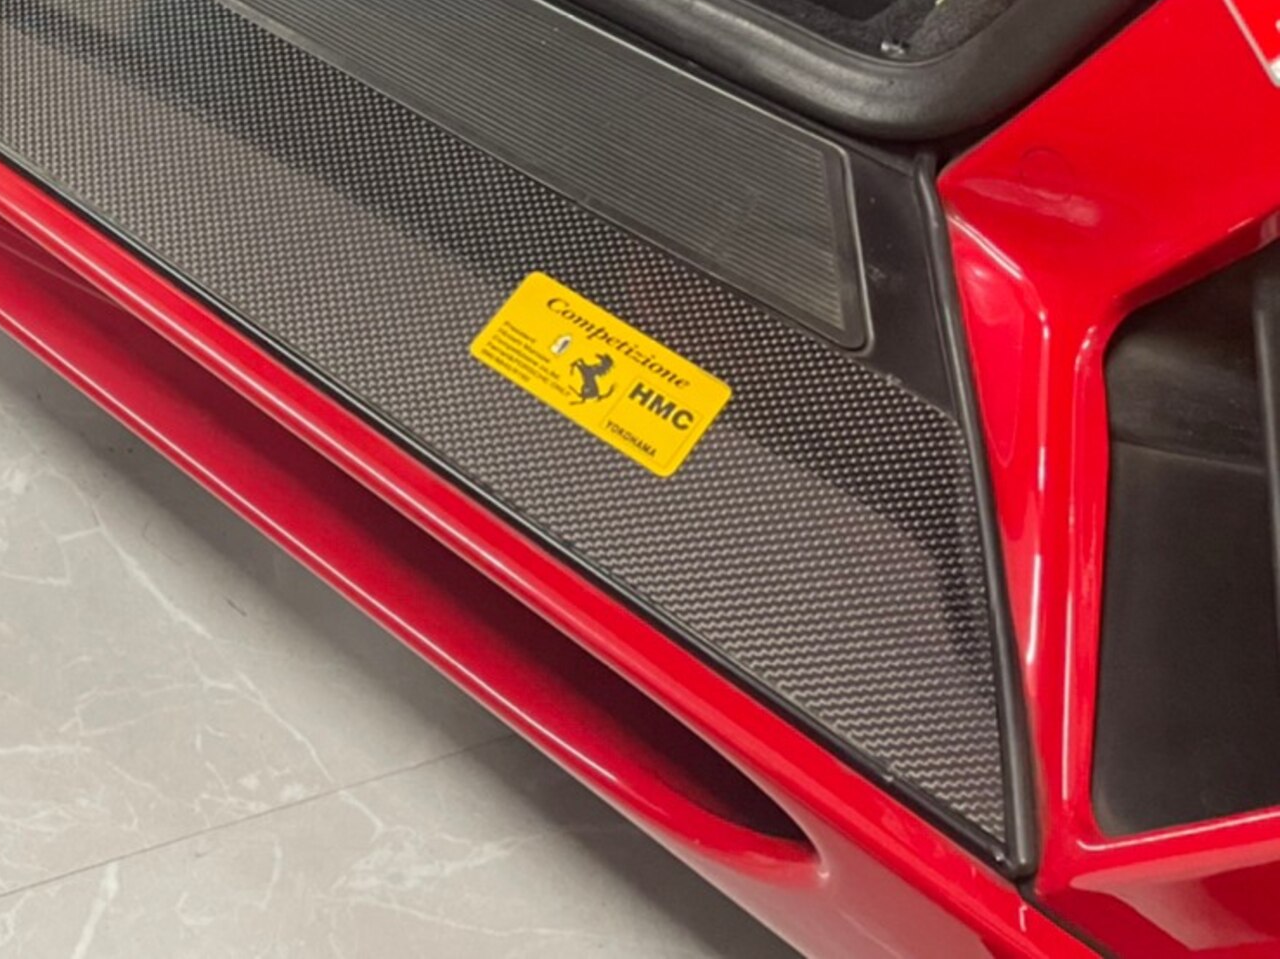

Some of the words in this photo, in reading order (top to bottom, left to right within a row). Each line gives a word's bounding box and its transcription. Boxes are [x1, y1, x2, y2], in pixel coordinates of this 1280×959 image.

[546, 297, 690, 390] Competizione
[628, 382, 695, 431] HMC
[606, 420, 658, 458] YOKOHAMA
